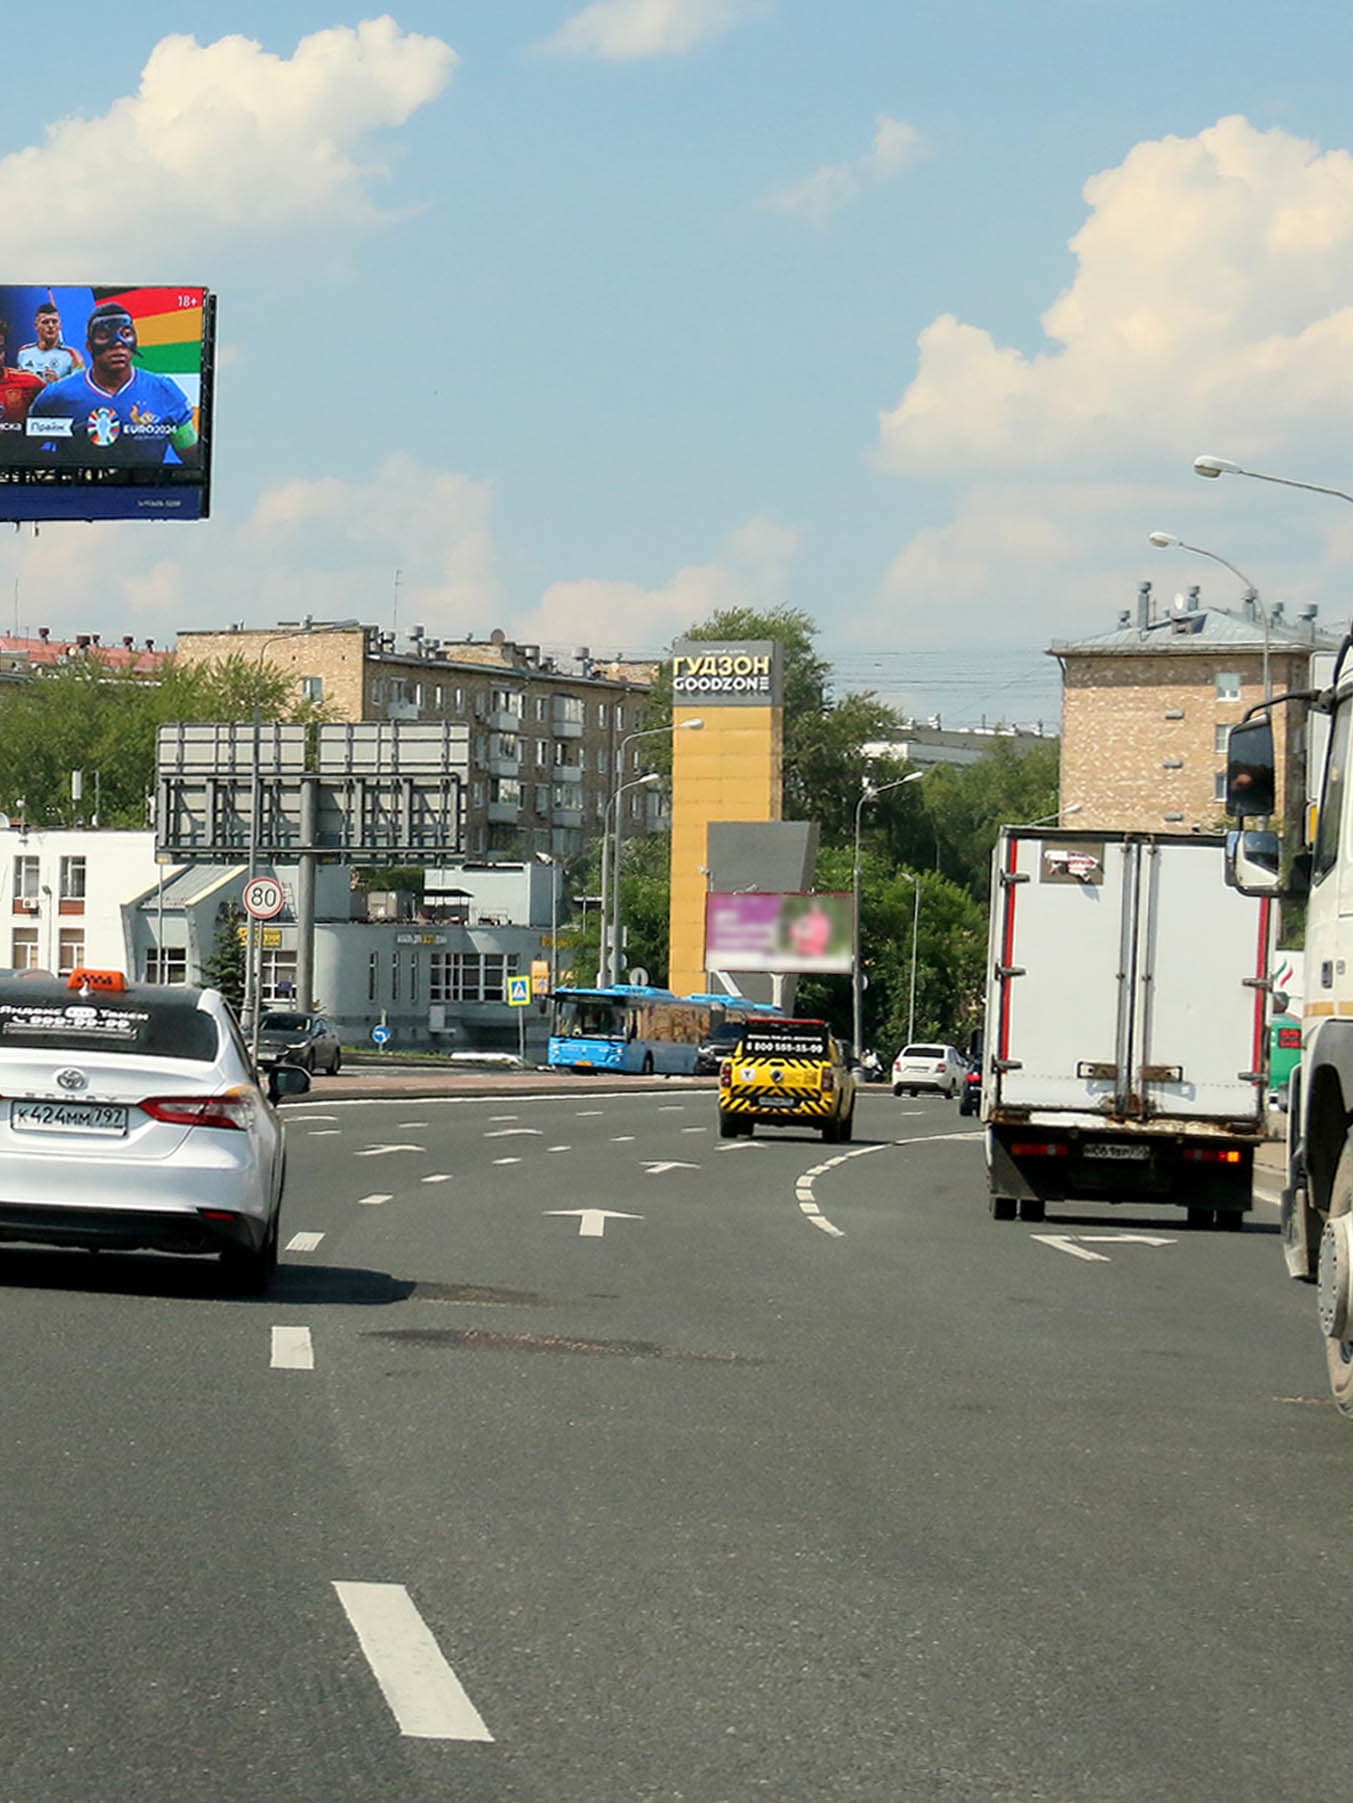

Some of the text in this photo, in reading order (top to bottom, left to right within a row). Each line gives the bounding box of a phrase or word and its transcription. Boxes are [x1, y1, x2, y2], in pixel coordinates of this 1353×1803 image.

[178, 295, 197, 307] 18+
[673, 656, 769, 676] ГУДЗОН
[673, 676, 769, 691] GOODZONE
[251, 887, 277, 907] 80
